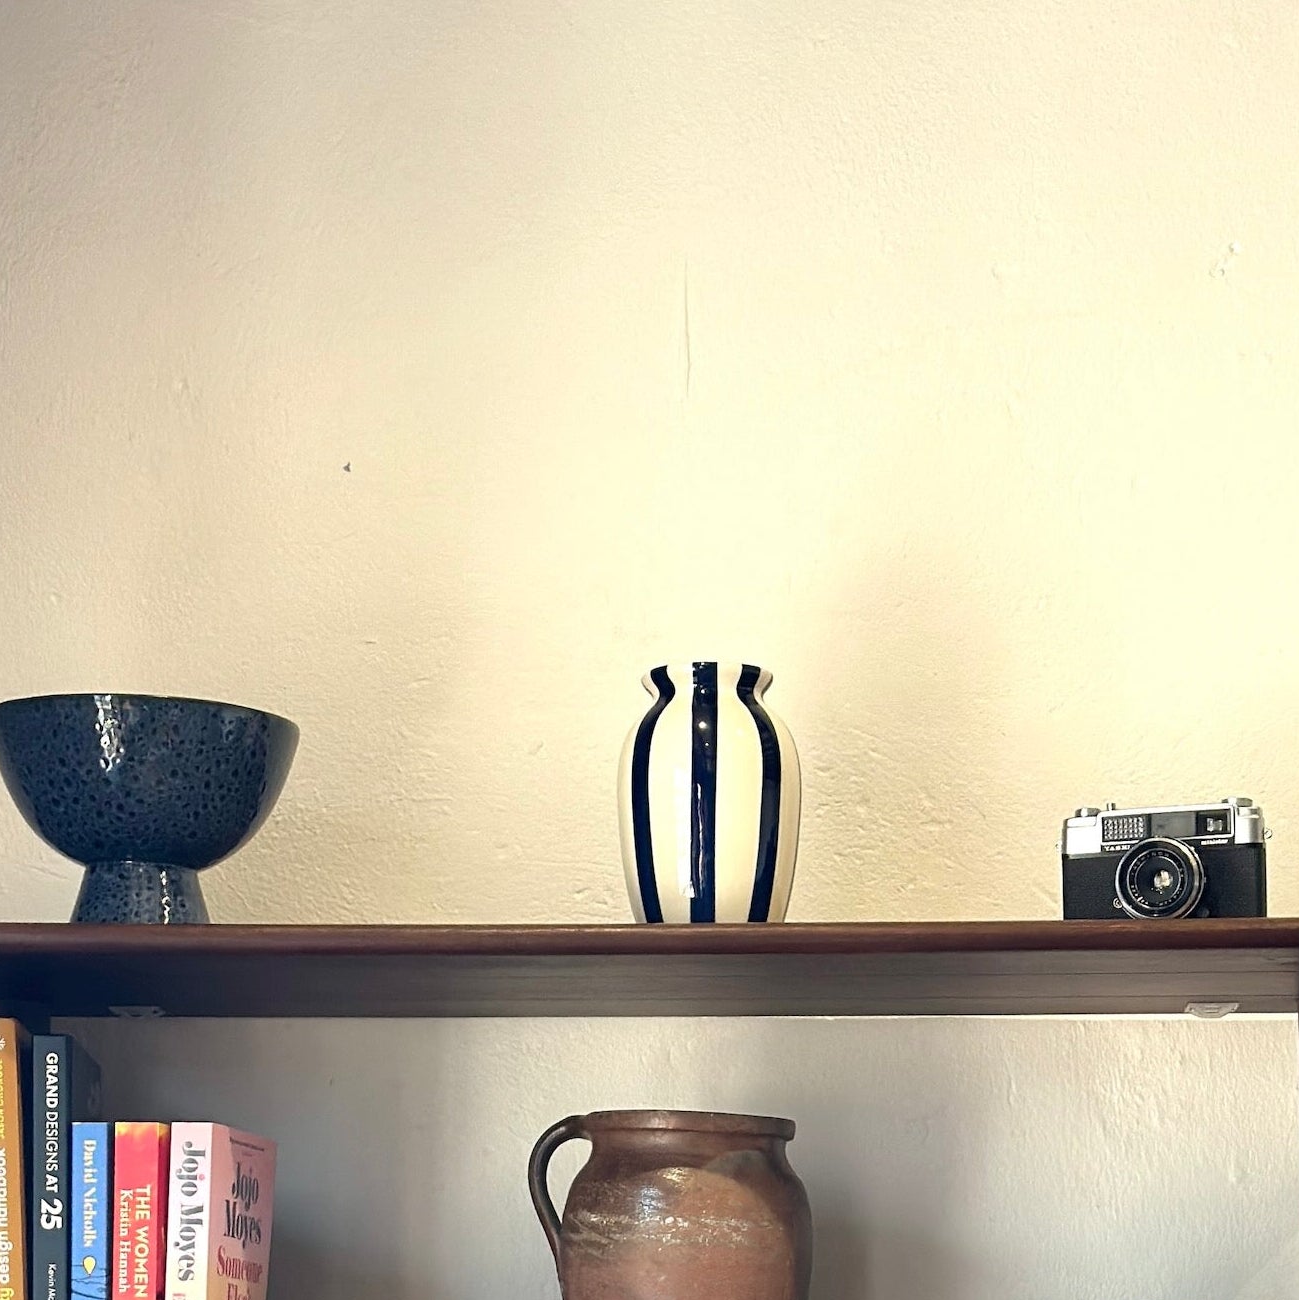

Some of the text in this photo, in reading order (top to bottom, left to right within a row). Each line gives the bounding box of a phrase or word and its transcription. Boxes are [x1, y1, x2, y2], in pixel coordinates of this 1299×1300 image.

[40, 1052, 63, 1231] GRAND DESIGNS AT 25
[82, 1139, 97, 1248] David Nicholls
[231, 1160, 260, 1211] Jojo
[118, 1189, 132, 1293] Kristin Hannah
[134, 1185, 150, 1298] THE WOMEN
[174, 1141, 206, 1282] Jojo Moyes
[223, 1199, 262, 1249] Moyes
[48, 1264, 56, 1285] Kevin
